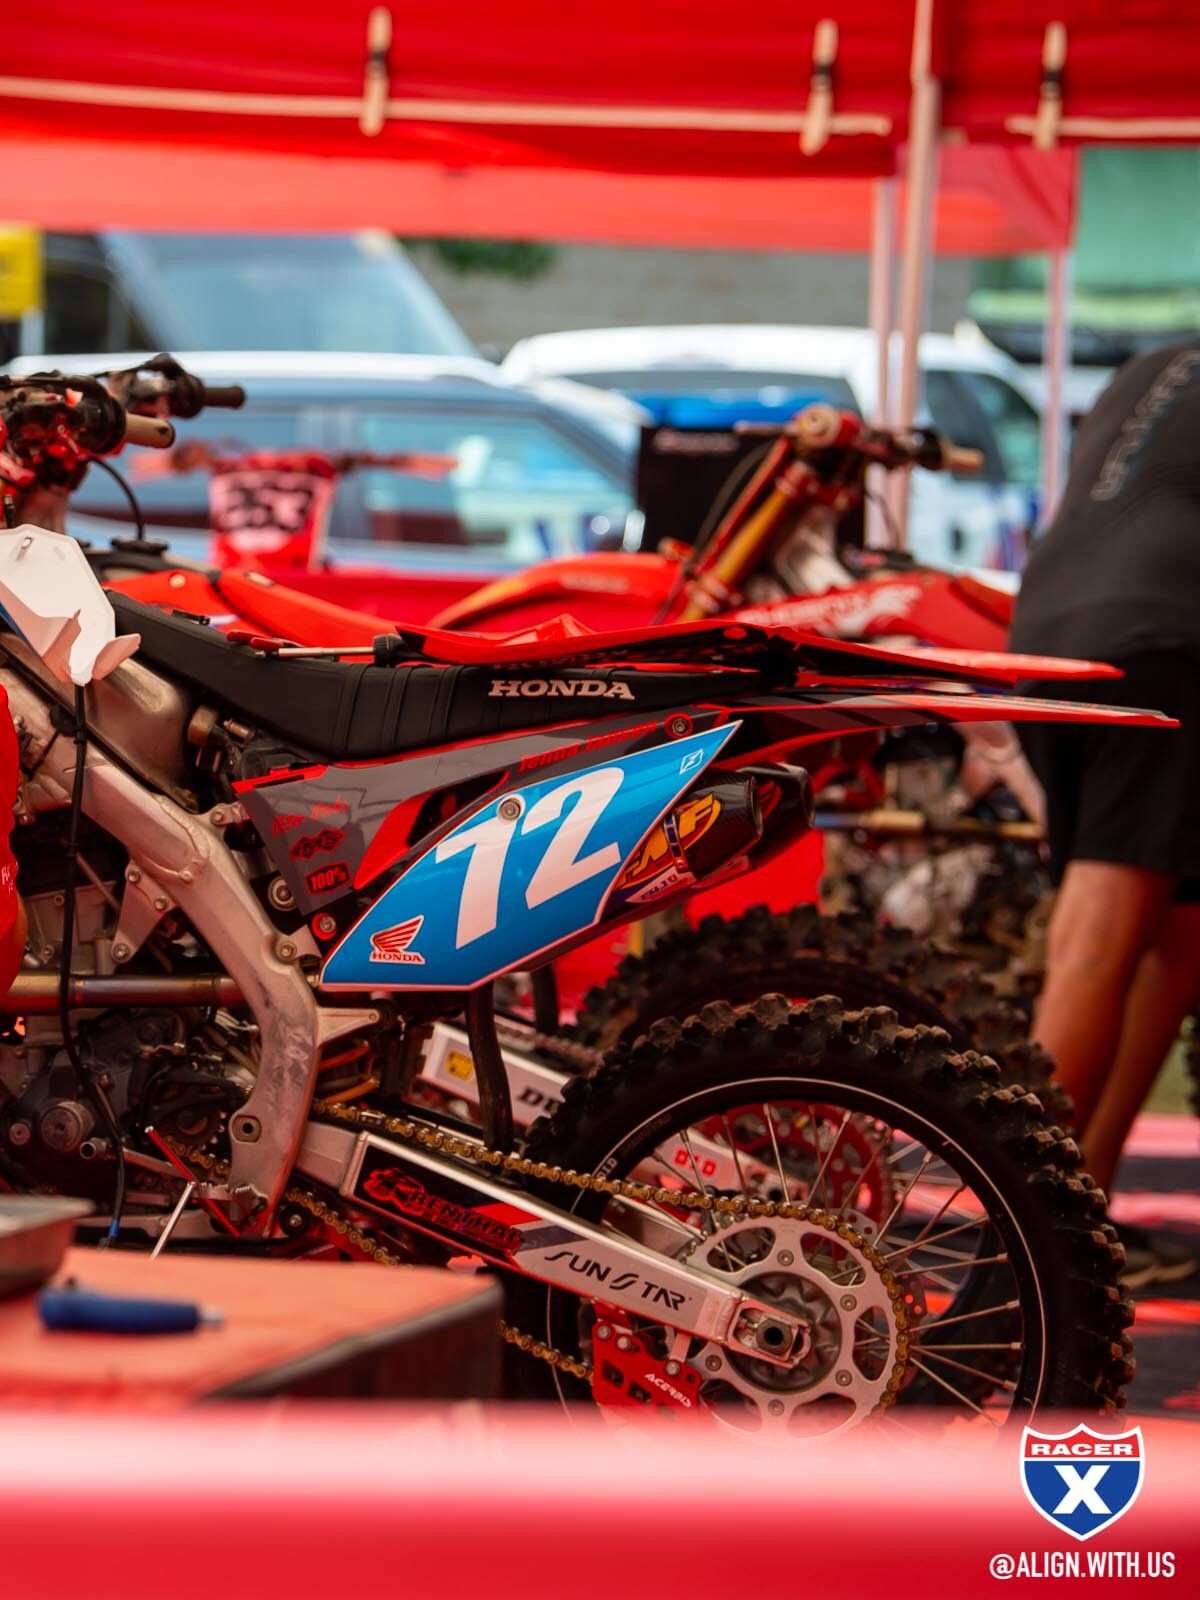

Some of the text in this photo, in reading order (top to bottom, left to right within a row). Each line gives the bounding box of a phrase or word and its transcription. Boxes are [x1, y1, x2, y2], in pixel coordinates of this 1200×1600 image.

[488, 679, 635, 700] HONDA
[311, 866, 347, 891] 100%
[371, 952, 423, 963] HONDA
